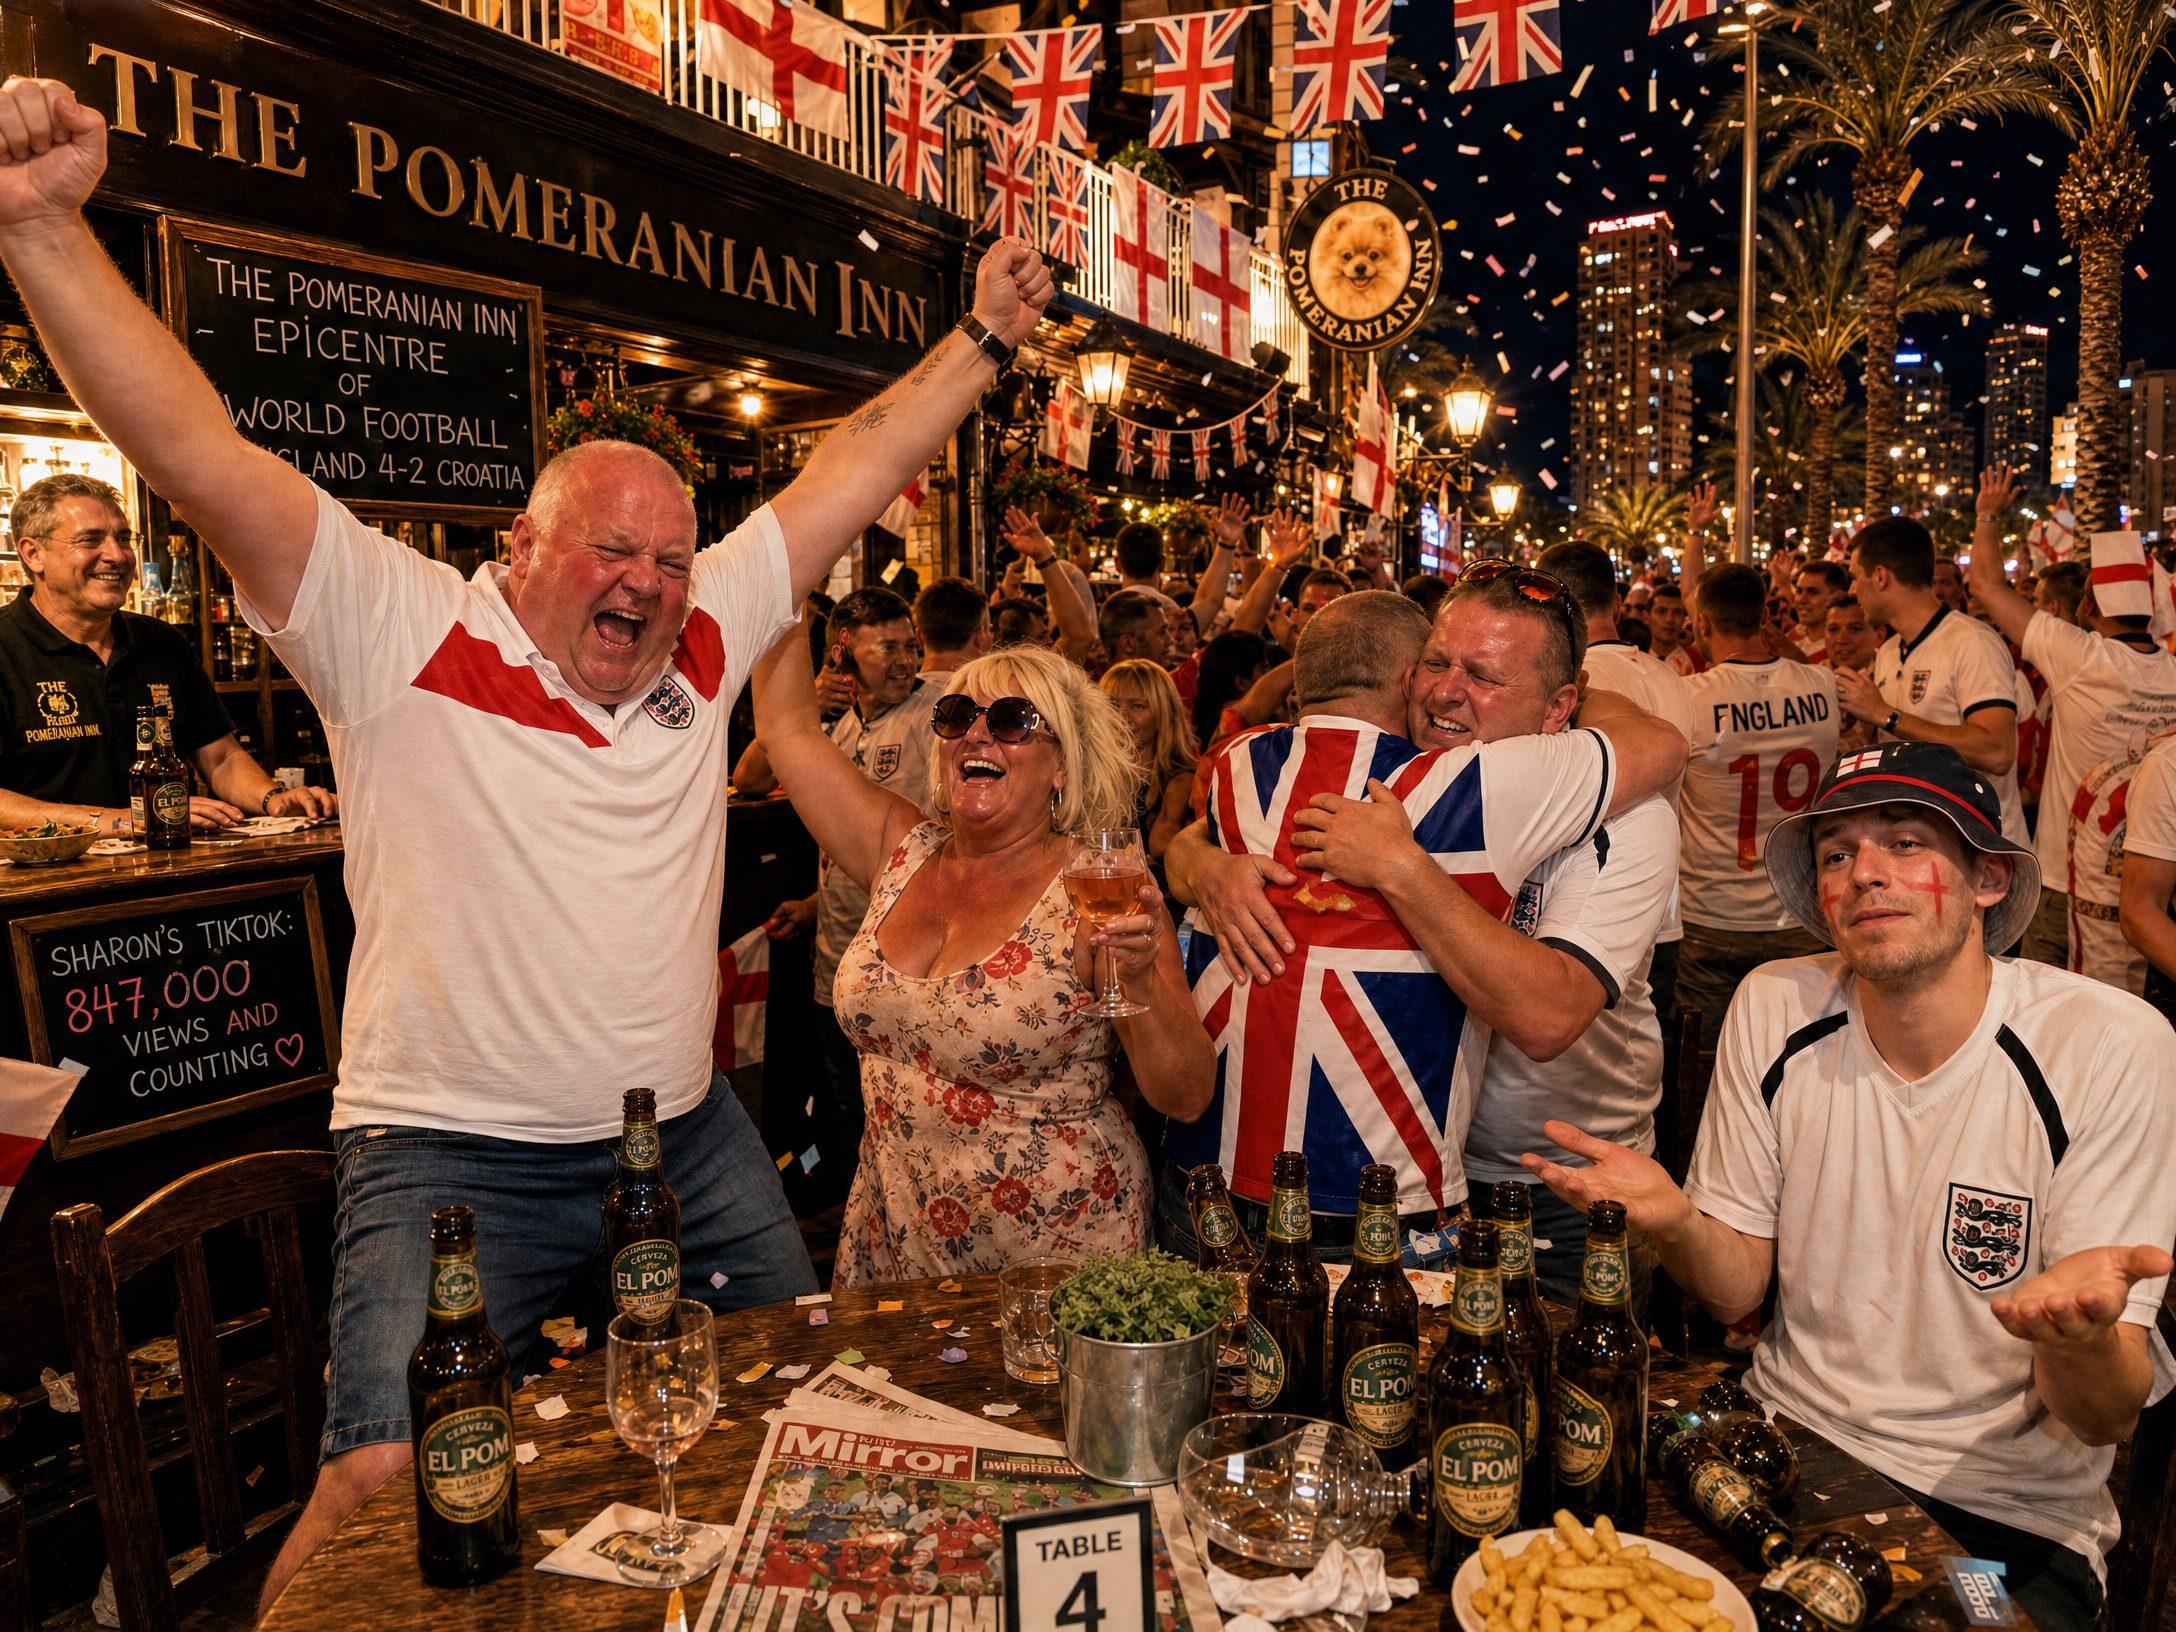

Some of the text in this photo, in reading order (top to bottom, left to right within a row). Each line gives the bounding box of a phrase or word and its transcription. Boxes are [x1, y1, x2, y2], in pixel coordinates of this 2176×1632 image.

[88, 43, 928, 349] THE POMERANIAN INN
[1333, 177, 1388, 202] THE
[206, 256, 275, 303] THE
[288, 271, 462, 332] POMERANIAN
[1288, 237, 1434, 343] POMERANIAN INN
[338, 372, 372, 397] OF
[224, 393, 509, 449] WORLD FOOTBALL
[378, 452, 427, 484] 4-2
[436, 459, 525, 491] CROATIA
[36, 681, 68, 694] THE
[1728, 747, 1821, 873] 19
[51, 909, 294, 977] SHARON'S TIKTOK:
[65, 959, 251, 1033] 847,000
[122, 1002, 279, 1057] VIEWS AND
[130, 1042, 269, 1097] COUNTING
[616, 1262, 678, 1291] EL POM
[1250, 1348, 1275, 1375] OM
[1350, 1370, 1417, 1399] EL POM
[445, 1421, 494, 1442] CERVEZA
[778, 1424, 969, 1475] Mirror
[1458, 1437, 1505, 1451] CERVEZA
[427, 1432, 510, 1472] EL POM
[1441, 1454, 1519, 1483] EL POM
[1035, 1530, 1123, 1563] TABLE
[1054, 1569, 1107, 1632] 4
